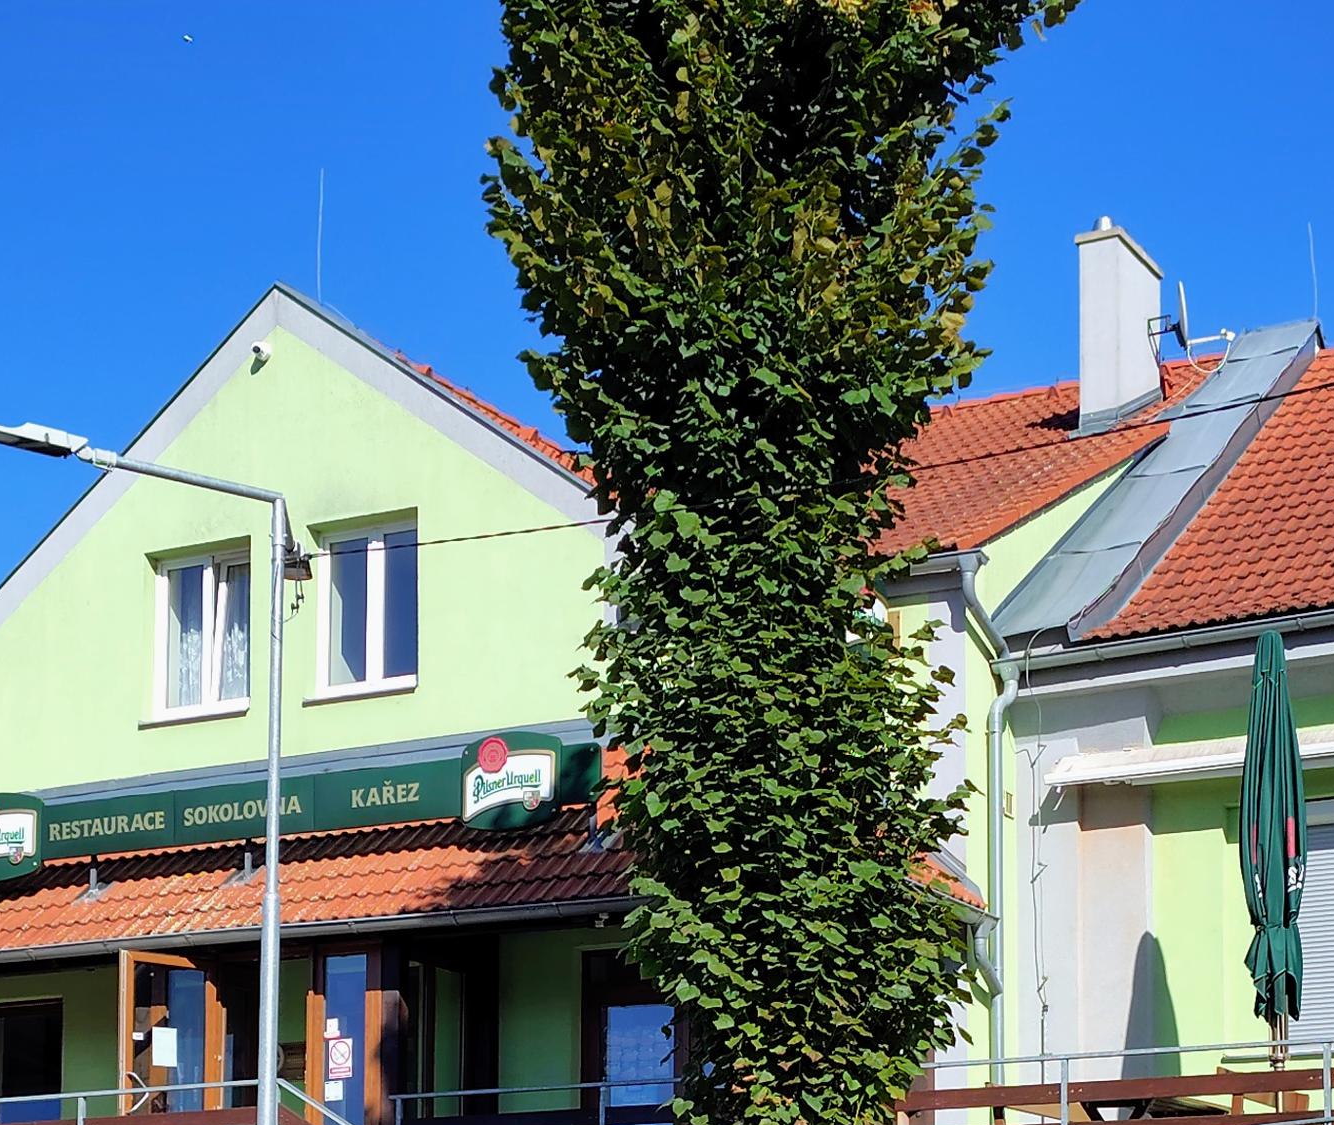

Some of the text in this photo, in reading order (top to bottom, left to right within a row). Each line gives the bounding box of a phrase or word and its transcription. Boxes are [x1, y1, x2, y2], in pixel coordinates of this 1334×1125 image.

[48, 811, 166, 842] RESTAURACE
[351, 779, 420, 809] KAŘEZ
[472, 768, 541, 804] Pilsner Urquell
